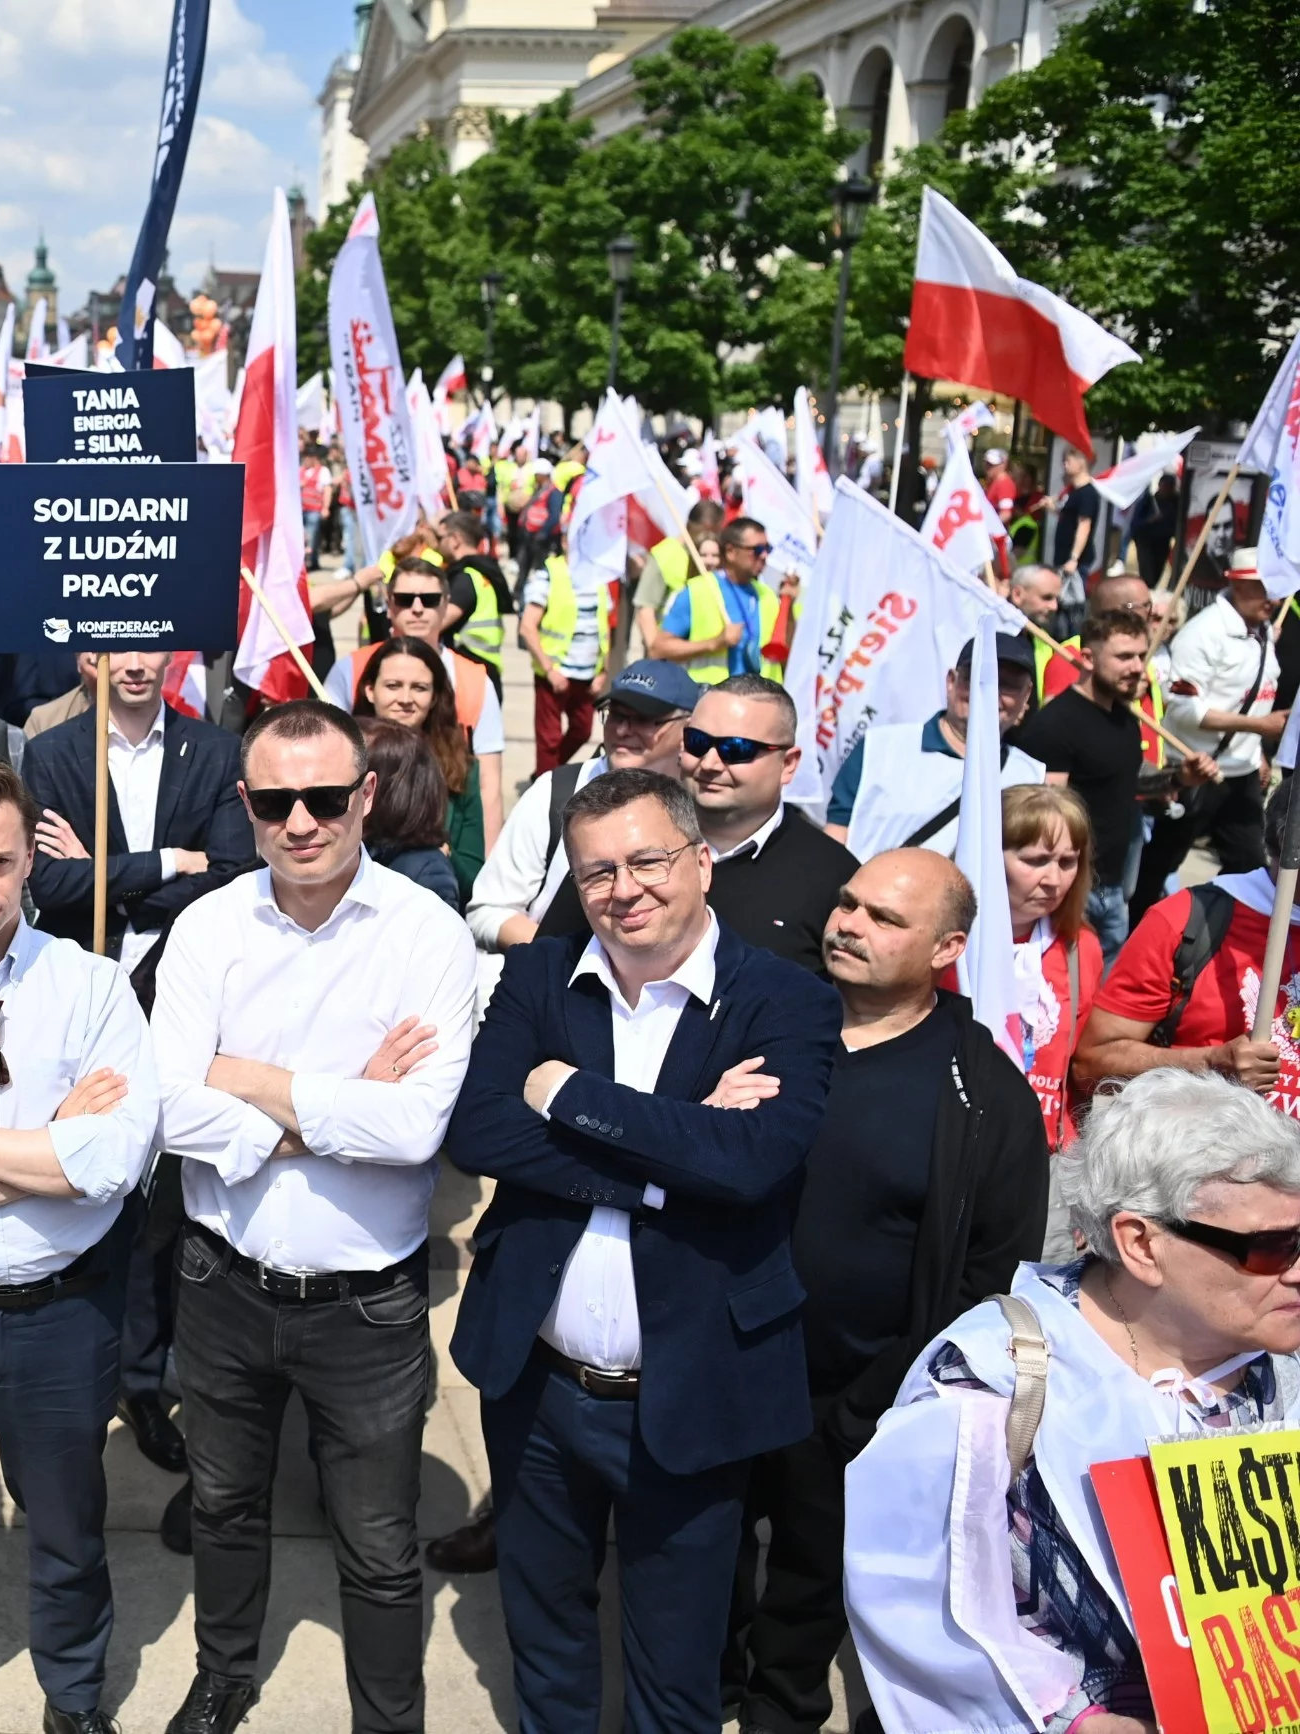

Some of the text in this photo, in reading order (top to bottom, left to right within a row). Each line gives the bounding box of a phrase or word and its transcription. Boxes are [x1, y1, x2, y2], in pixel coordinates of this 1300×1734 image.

[73, 388, 139, 411] TANIA
[74, 414, 141, 432] ENERGIA
[75, 434, 142, 453] = SILNA
[34, 498, 188, 522] SOLIDARNI
[44, 530, 176, 560] Z LUDŹMI
[63, 574, 158, 597] PRACY
[77, 620, 174, 633] KONFEDERACJA
